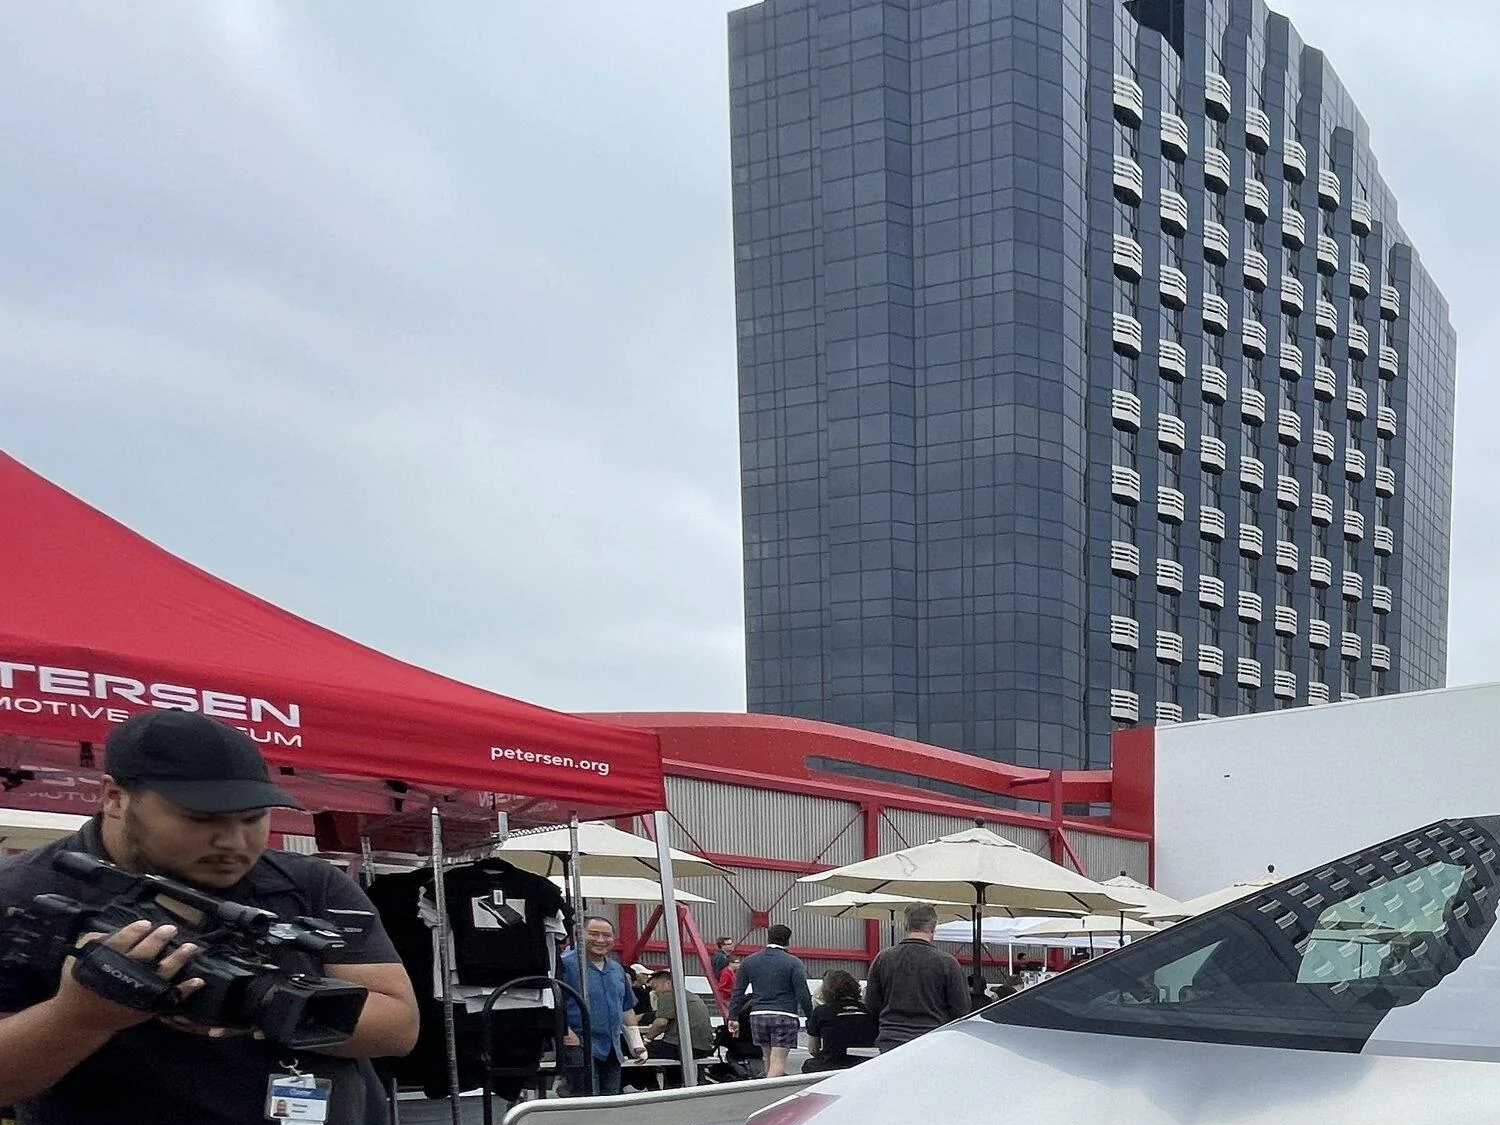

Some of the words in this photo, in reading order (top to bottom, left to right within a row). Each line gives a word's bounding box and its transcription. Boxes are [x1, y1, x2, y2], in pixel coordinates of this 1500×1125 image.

[0, 661, 300, 727] TERSEN
[491, 746, 610, 776] petersen.org
[101, 963, 144, 988] SONY
